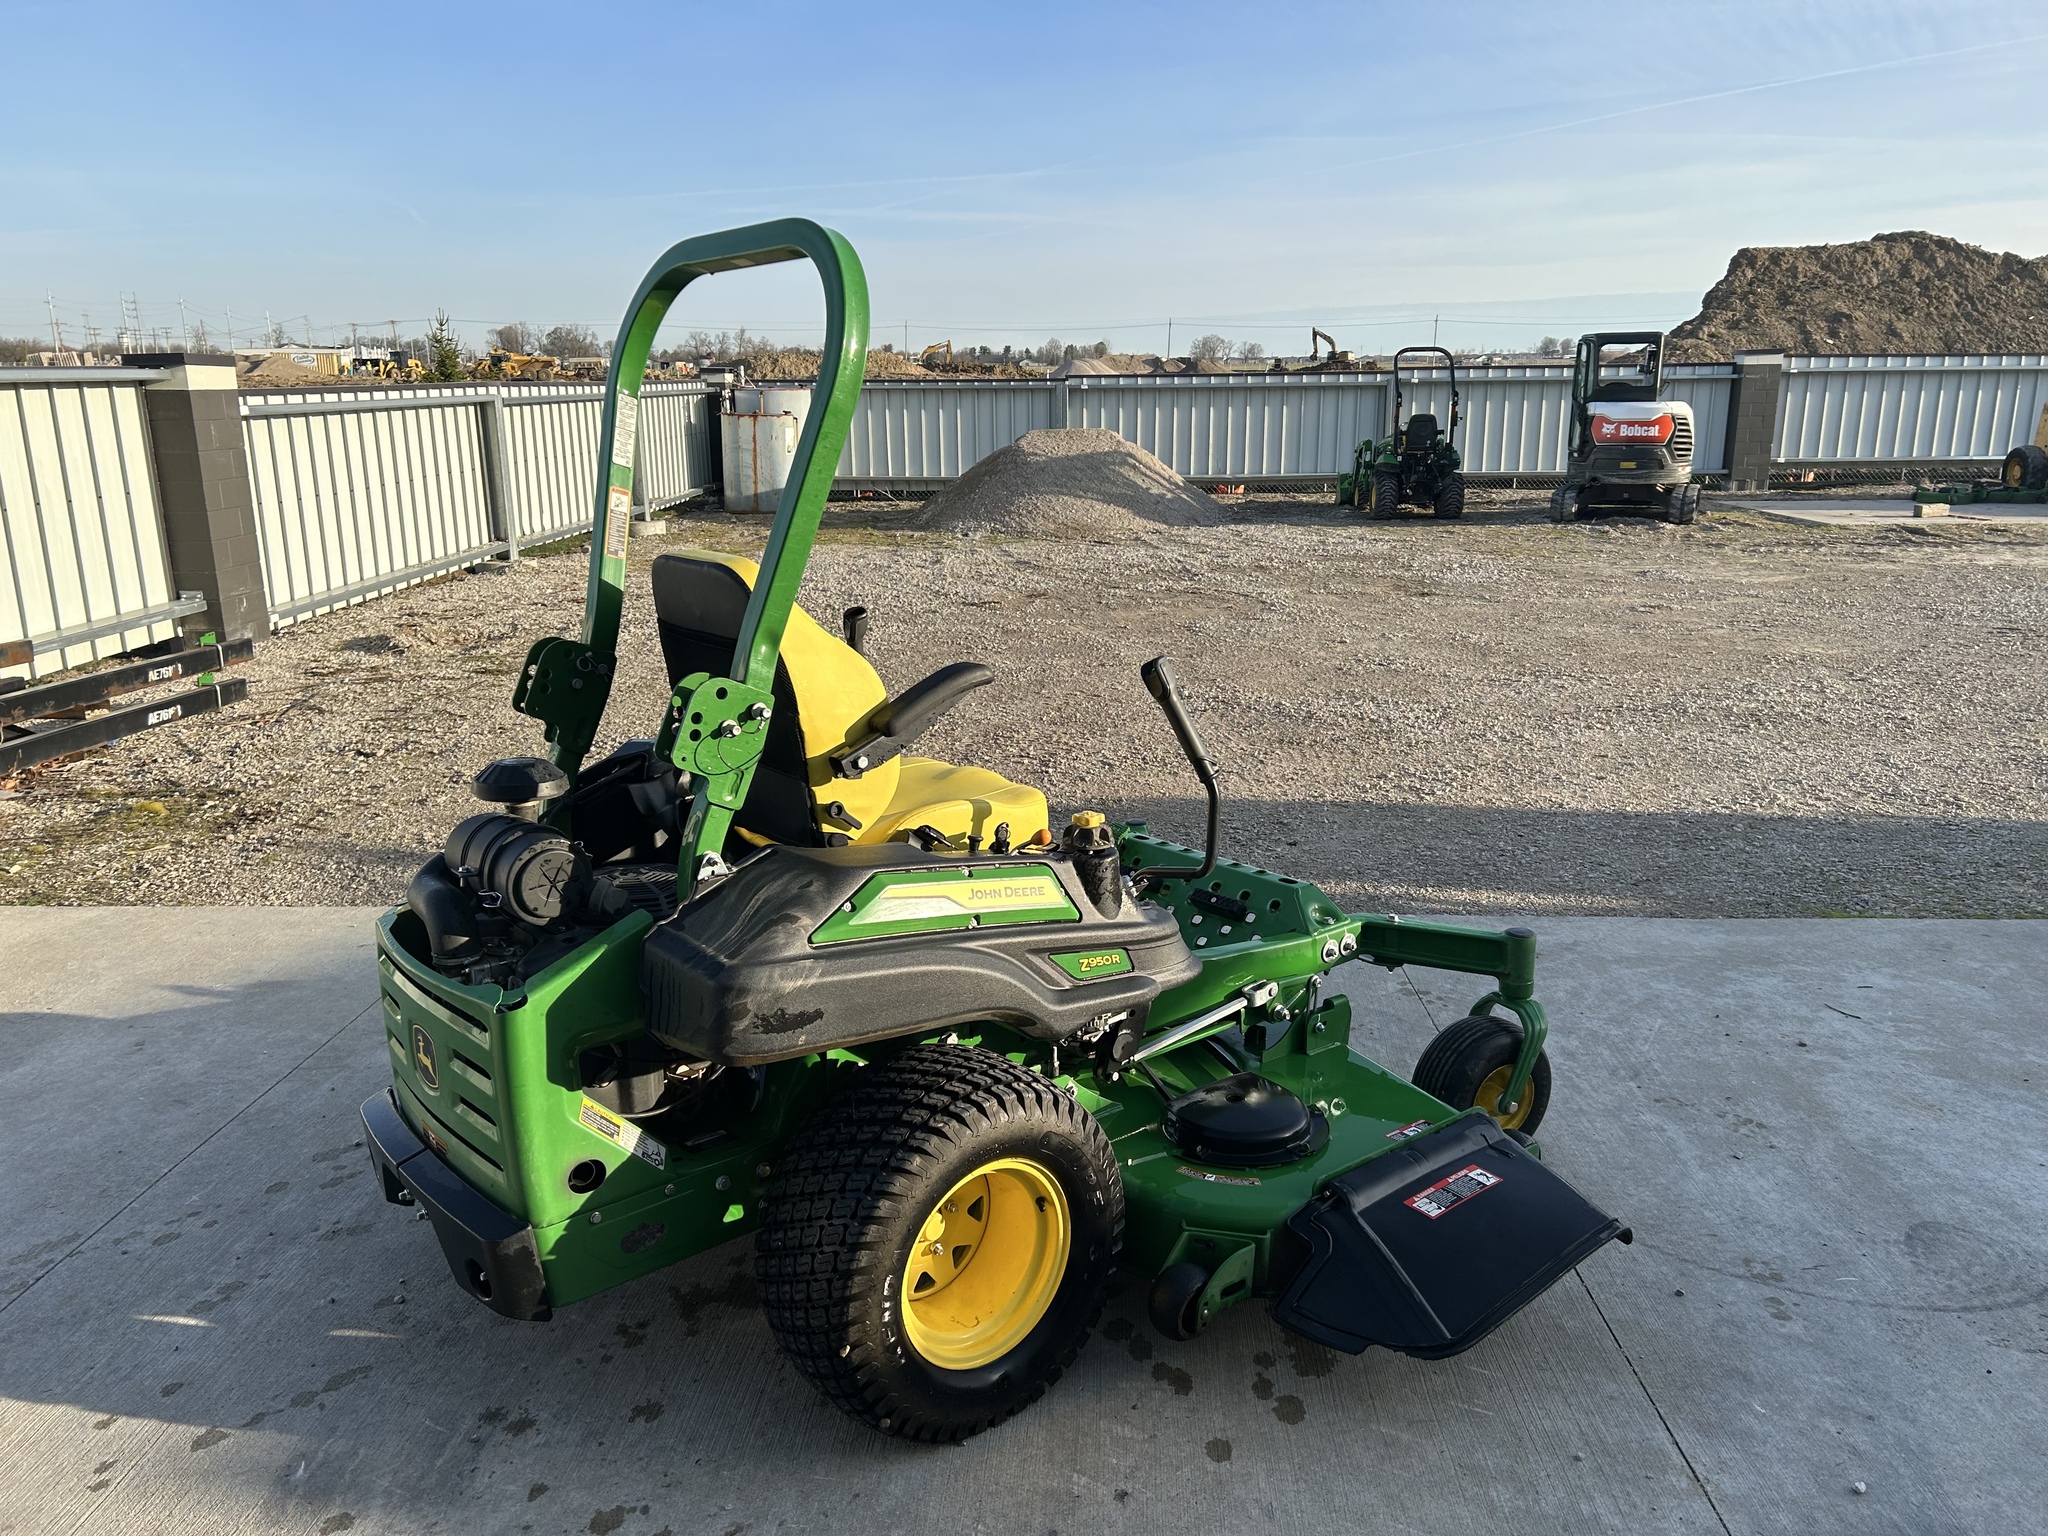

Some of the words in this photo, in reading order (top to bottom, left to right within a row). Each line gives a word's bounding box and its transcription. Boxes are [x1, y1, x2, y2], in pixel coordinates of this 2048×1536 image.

[1620, 424, 1659, 437] Bobcat
[968, 888, 1002, 900] JOHN
[1004, 886, 1046, 898] DEERE
[1078, 954, 1121, 972] Z950R
